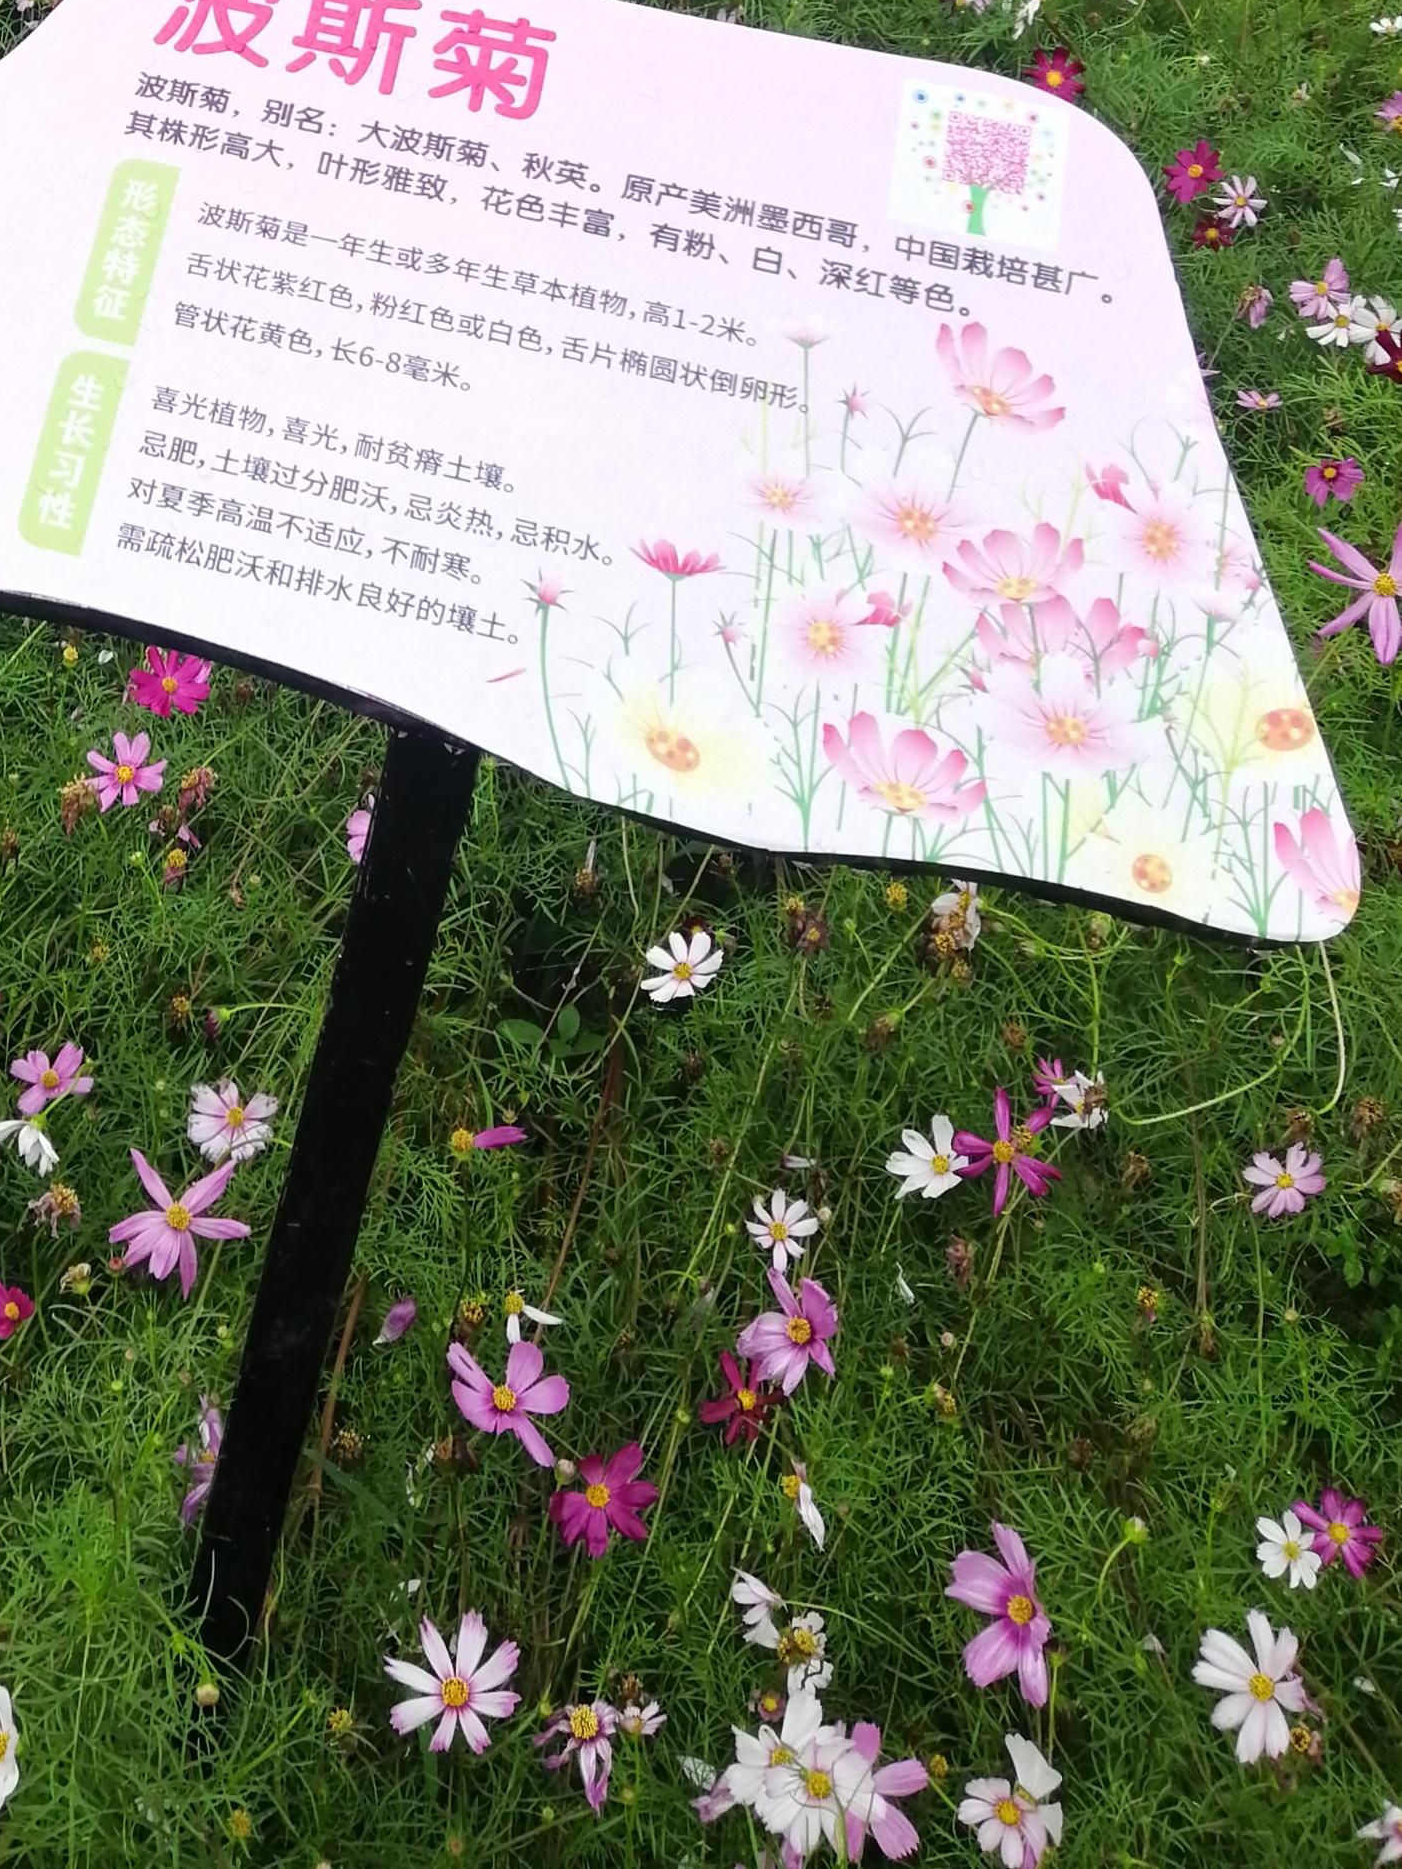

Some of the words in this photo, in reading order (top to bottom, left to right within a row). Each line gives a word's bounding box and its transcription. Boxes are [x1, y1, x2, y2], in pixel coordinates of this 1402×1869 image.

[92, 178, 158, 323] 形态特征
[36, 373, 104, 530] 生长习性
[116, 522, 519, 645] 需疏松肥沃和排水良好的壤土。
